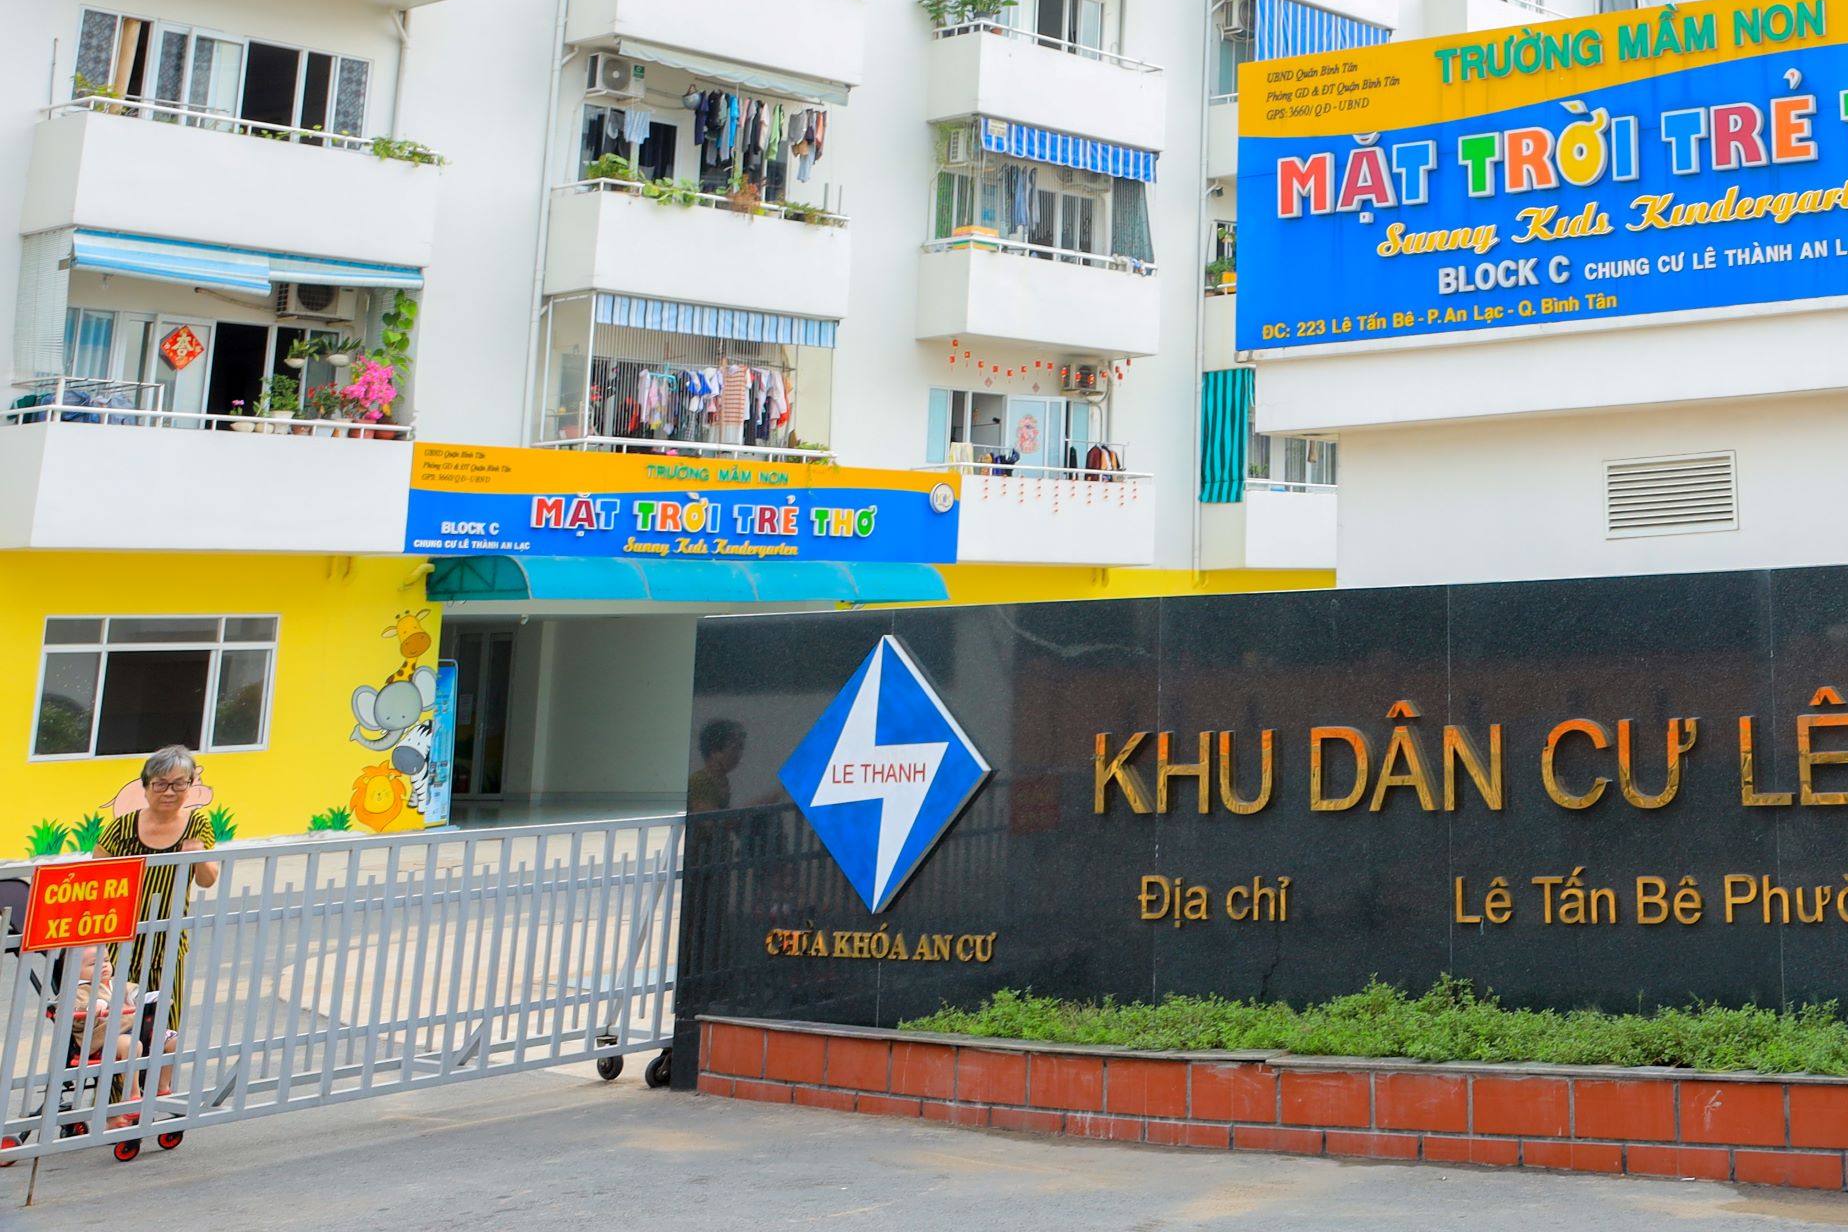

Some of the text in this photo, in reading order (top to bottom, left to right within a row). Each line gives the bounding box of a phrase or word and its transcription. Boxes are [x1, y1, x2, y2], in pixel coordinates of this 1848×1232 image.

[1434, 0, 1826, 84] TRƯỜNG MẦM NON
[1266, 70, 1294, 83] UBND
[1295, 87, 1309, 98] GD
[1321, 83, 1336, 96] ĐT
[1277, 132, 1438, 224] MẶT
[1458, 99, 1639, 198] TRỜI
[1661, 68, 1818, 175] TRẺ
[1376, 221, 1501, 258] Sunny
[1511, 201, 1615, 243] Kids
[1437, 257, 1539, 296] BLOCK
[1548, 255, 1571, 285] C
[1584, 256, 1650, 281] CHUNG
[1657, 250, 1687, 274] CƯ
[1692, 246, 1718, 271] LÊ
[1724, 241, 1793, 267] THÀNH
[1799, 240, 1829, 260] AN
[1262, 324, 1290, 340] ĐC:
[1296, 320, 1326, 337] 223
[1332, 316, 1352, 333] Lê
[1357, 311, 1387, 331] Tấn
[1392, 311, 1415, 328] Bê
[1474, 305, 1504, 324] Lạc
[1518, 300, 1536, 317] Q.
[1541, 296, 1579, 314] Bình
[1585, 293, 1618, 310] Tân
[647, 463, 710, 481] TRƯỜNG
[759, 471, 789, 484] NON
[441, 521, 500, 536] BLOCK C
[530, 492, 877, 537] MẶT TRỜI TRẺ THƠ
[413, 539, 442, 548] CHUNG
[444, 539, 458, 549] CƯ
[458, 538, 469, 549] LÊ
[500, 542, 512, 550] AN
[514, 542, 531, 552] LẠC
[623, 536, 798, 558] Sunny Kids Kindergarten
[831, 763, 926, 784] LE THANH
[1094, 728, 1276, 815] KHU
[1310, 700, 1504, 813] DÂN
[1541, 717, 1699, 809] CƯ
[44, 872, 129, 905] CỔNG RA
[1138, 874, 1209, 929] Địa
[1226, 875, 1292, 922] chỉ
[1455, 876, 1513, 923] Lê
[1531, 866, 1618, 924] Tấn
[1635, 873, 1702, 923] Bê
[45, 908, 118, 940] XE ÔTÔ
[766, 919, 998, 962] CHÌA KHÓA AN CƯ
